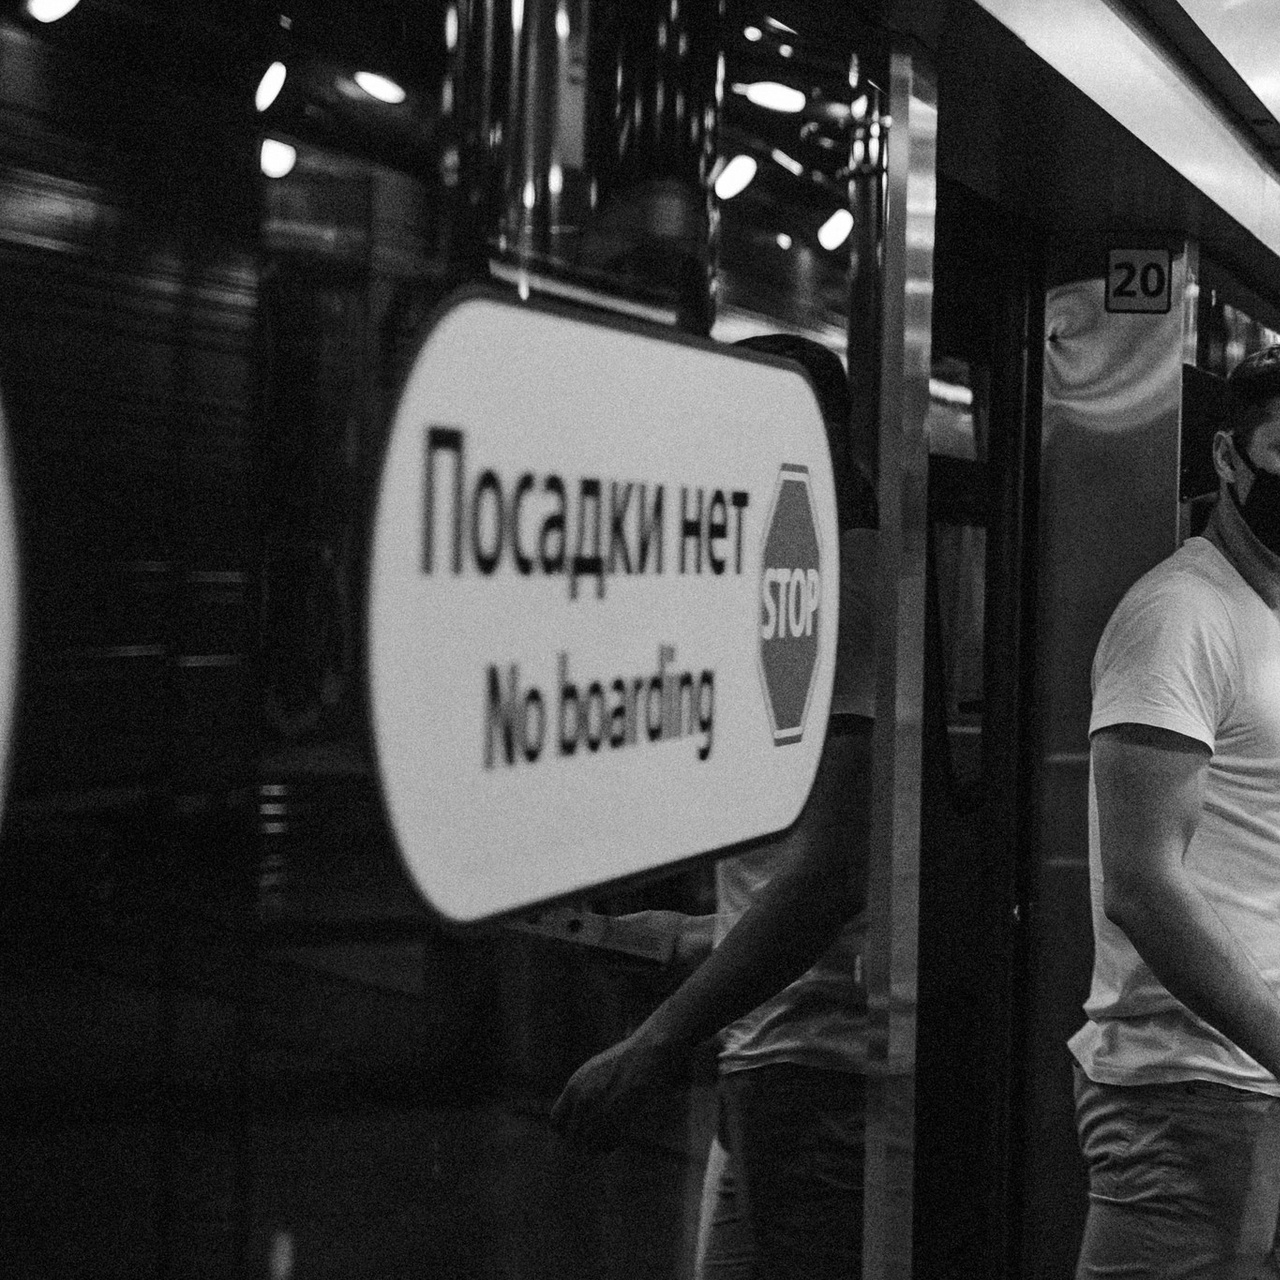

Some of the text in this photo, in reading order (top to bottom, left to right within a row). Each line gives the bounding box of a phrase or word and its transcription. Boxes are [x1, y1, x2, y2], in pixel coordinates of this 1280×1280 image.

[1112, 261, 1166, 299] 20
[421, 425, 750, 599] Посадки нет
[761, 567, 819, 638] STOP
[484, 645, 715, 769] No boarding
